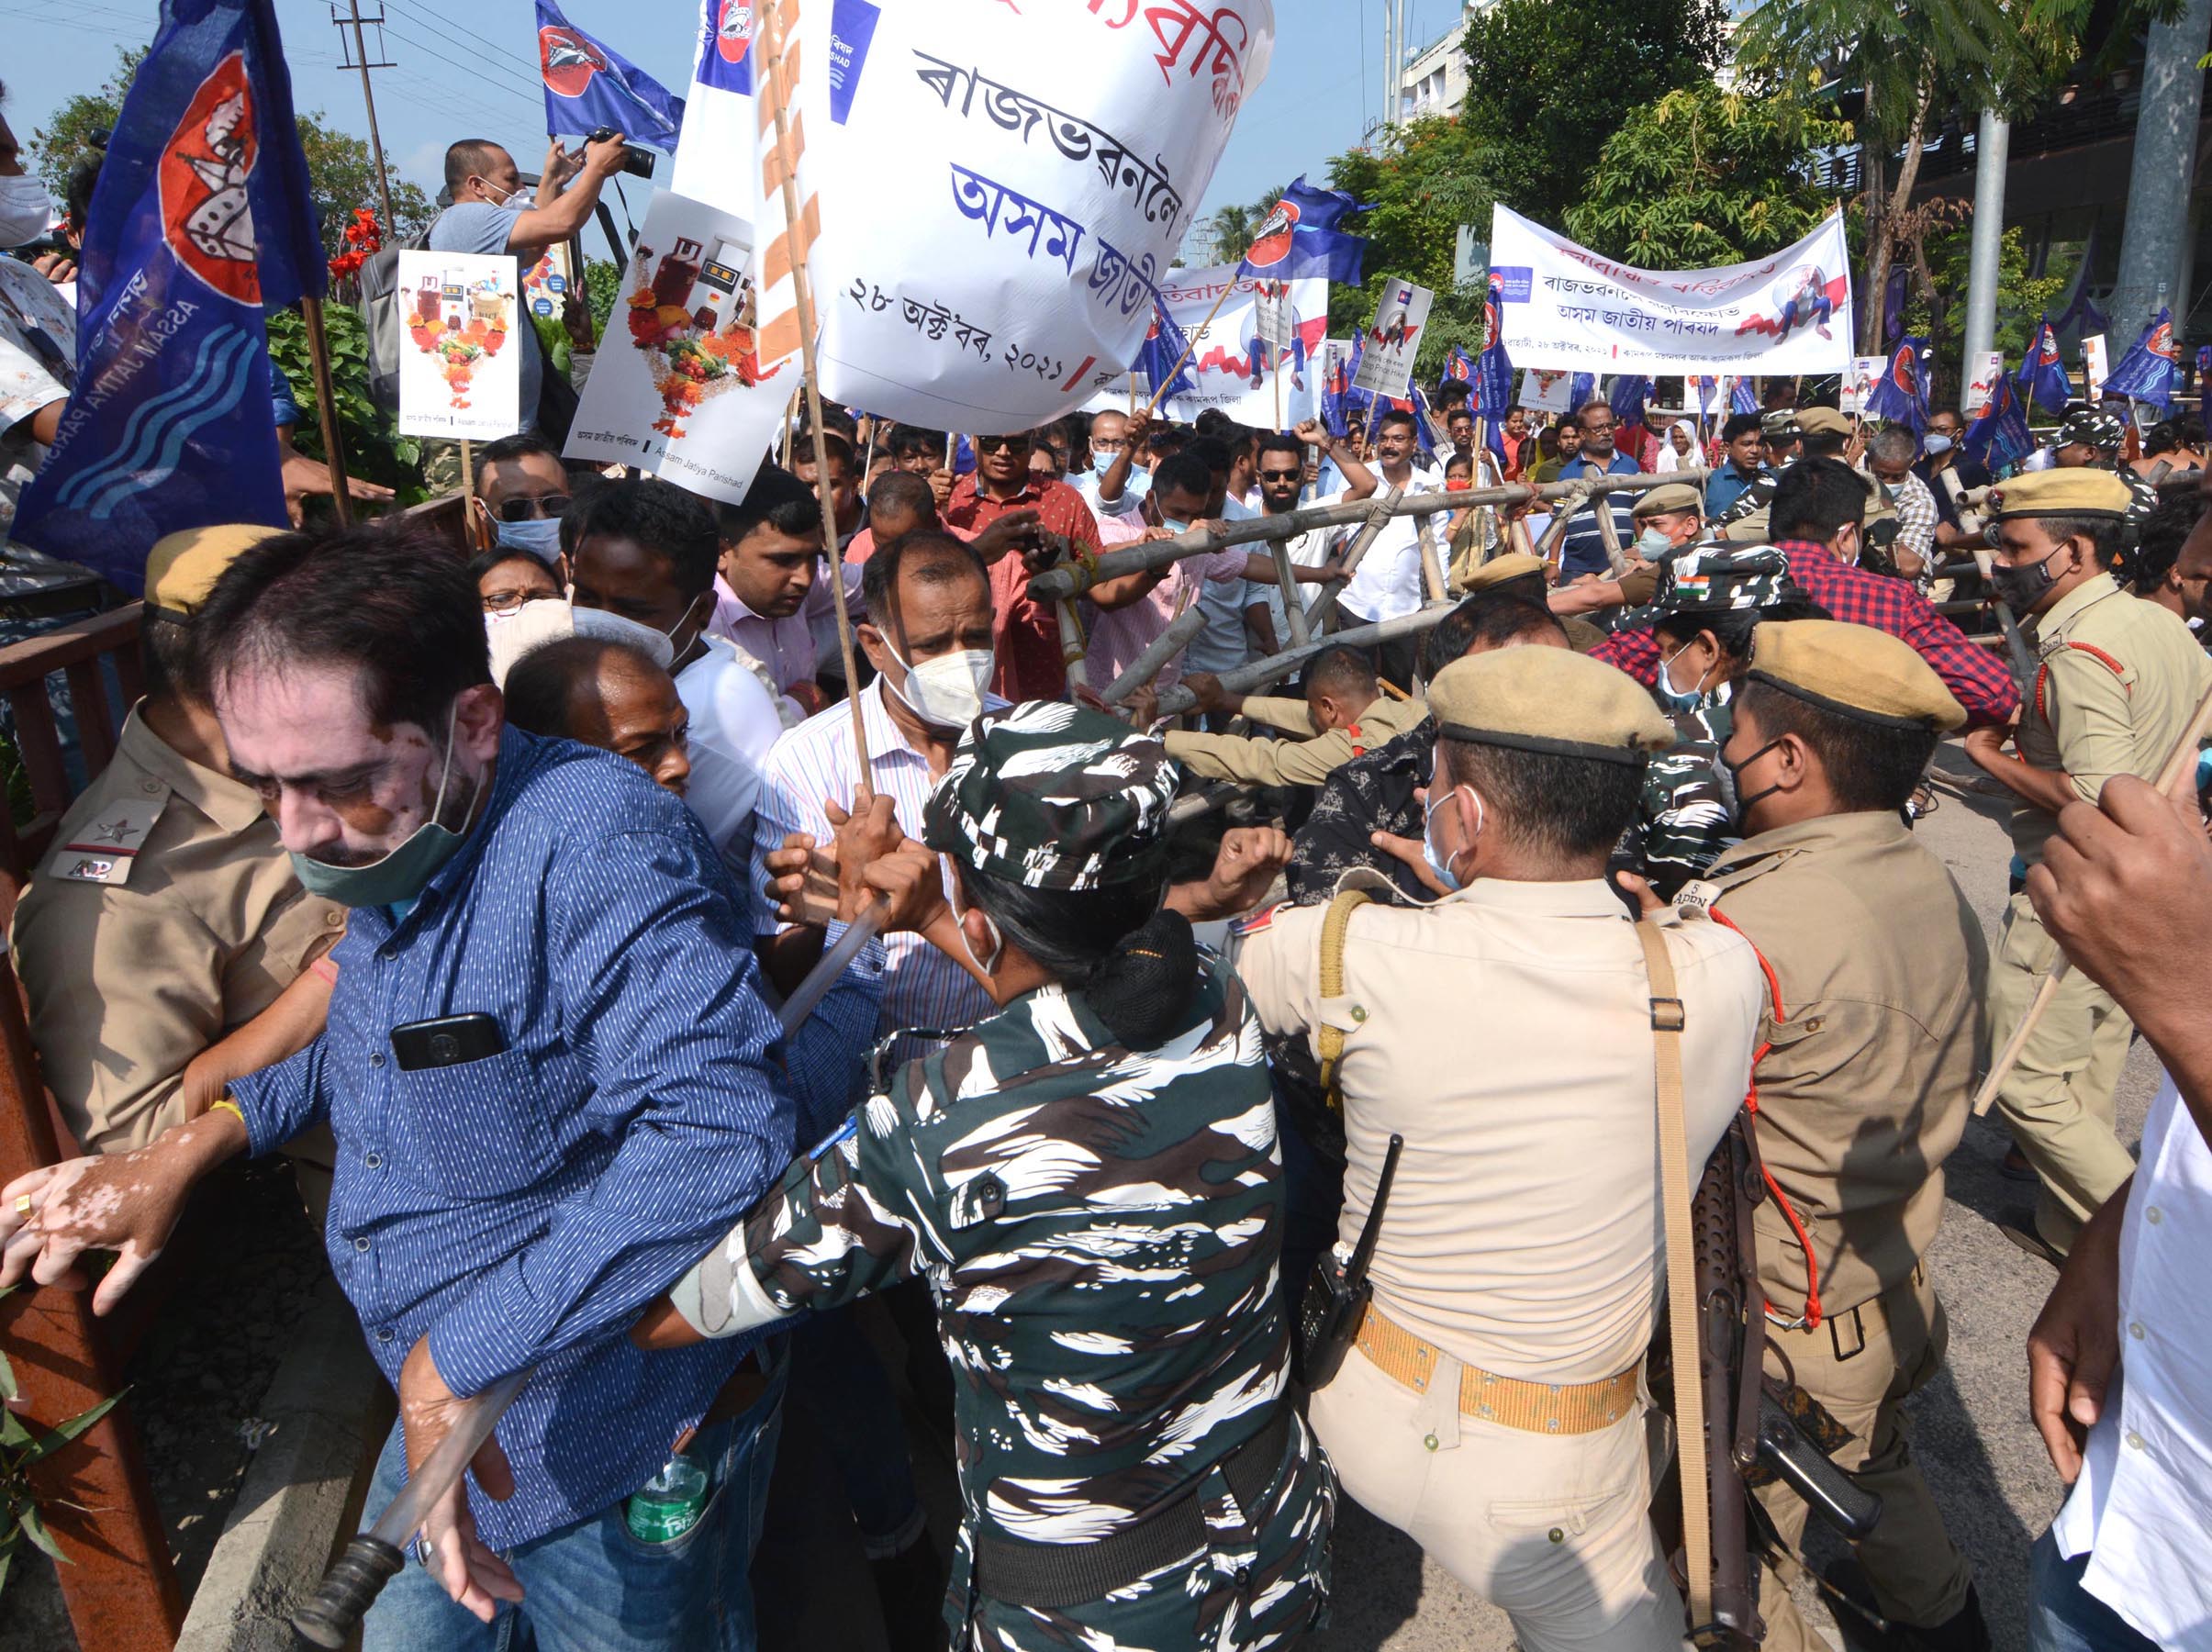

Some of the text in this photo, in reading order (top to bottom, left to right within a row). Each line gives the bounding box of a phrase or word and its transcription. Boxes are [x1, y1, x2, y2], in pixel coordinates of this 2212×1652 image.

[911, 49, 1182, 239] ৰাজভৱনলৈ
[950, 162, 1158, 323] অসম জাতী
[1160, 279, 1255, 303] তিবাদত
[850, 277, 894, 312] ২৮
[1005, 343, 1062, 381] ২০২১
[1557, 304, 1597, 324] অসম
[1602, 307, 1658, 331] জাতীয়
[1186, 394, 1218, 405] কামৰূপ
[1220, 393, 1241, 406] জিলা
[654, 446, 744, 489] Assam Jatiya Parishad
[1691, 883, 1701, 895] 5
